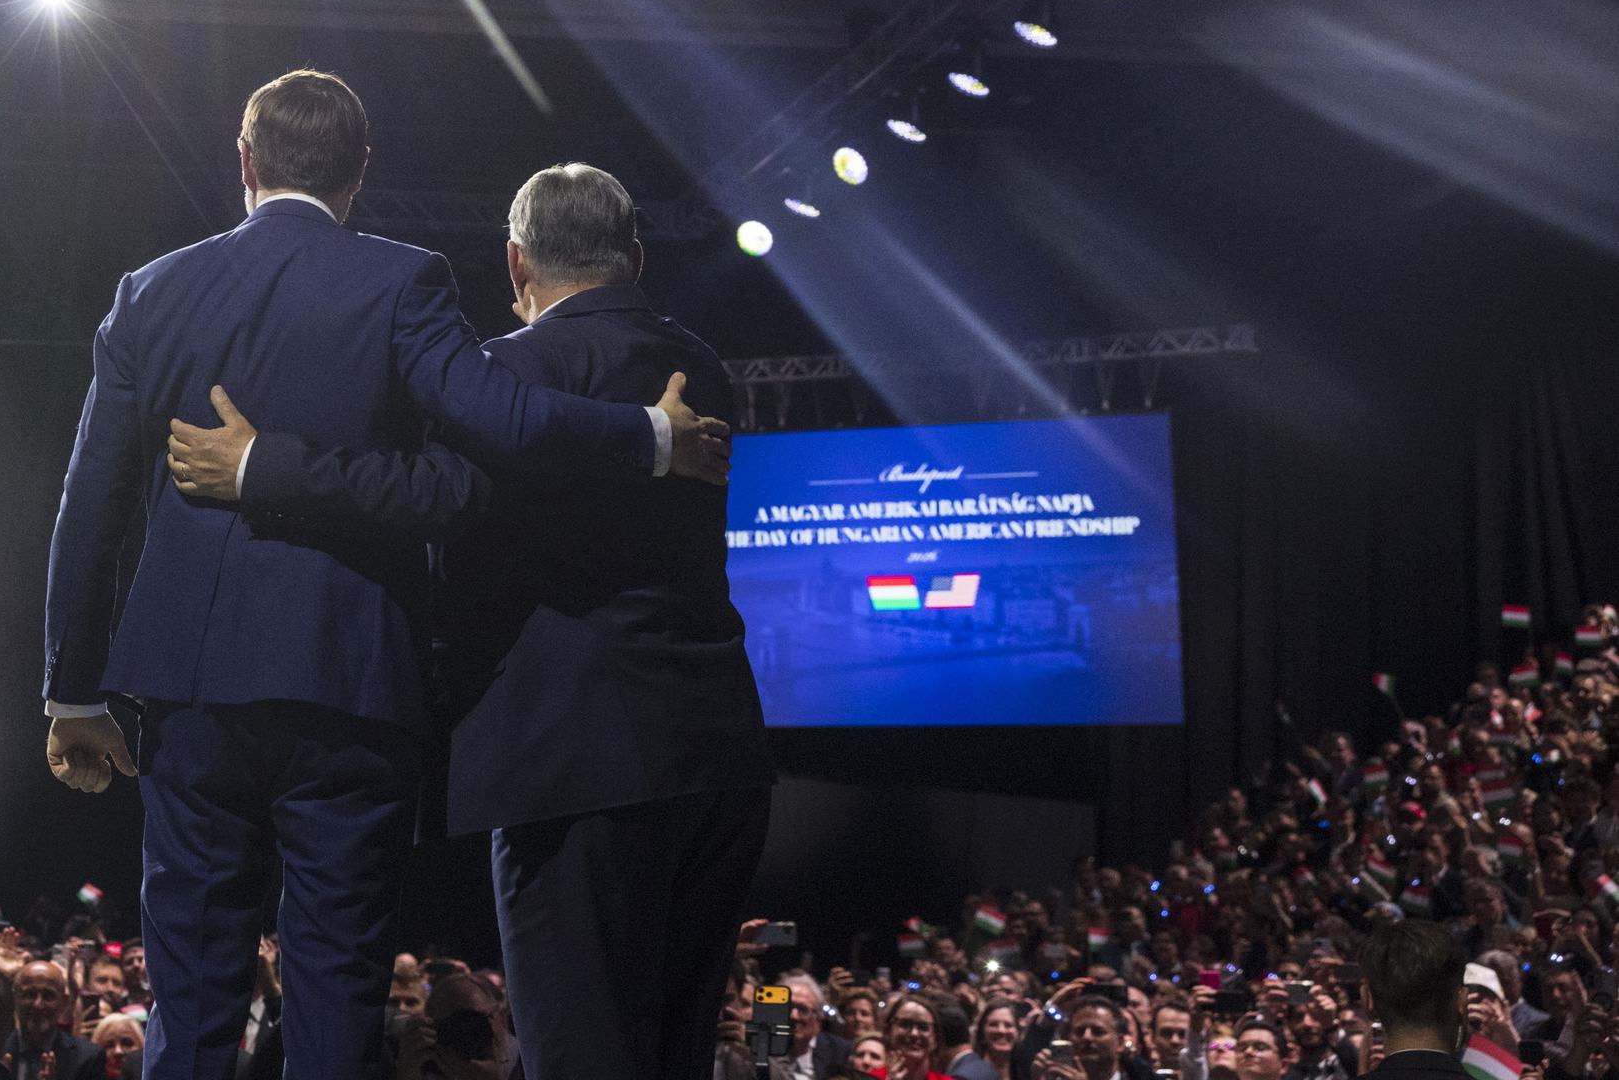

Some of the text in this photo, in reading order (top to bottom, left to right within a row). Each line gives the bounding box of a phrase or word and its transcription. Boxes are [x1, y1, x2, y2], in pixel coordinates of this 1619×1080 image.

[755, 507, 769, 523] A
[771, 504, 845, 522] MAGYAR
[848, 500, 937, 520] AMERIKAI
[1037, 493, 1094, 516] NAPJA
[755, 528, 790, 547] DAY
[791, 527, 816, 545] OF
[818, 524, 926, 545] HUNGARIAN
[928, 520, 1024, 541] AMERICAN
[1025, 516, 1141, 538] FRIENDSHIP
